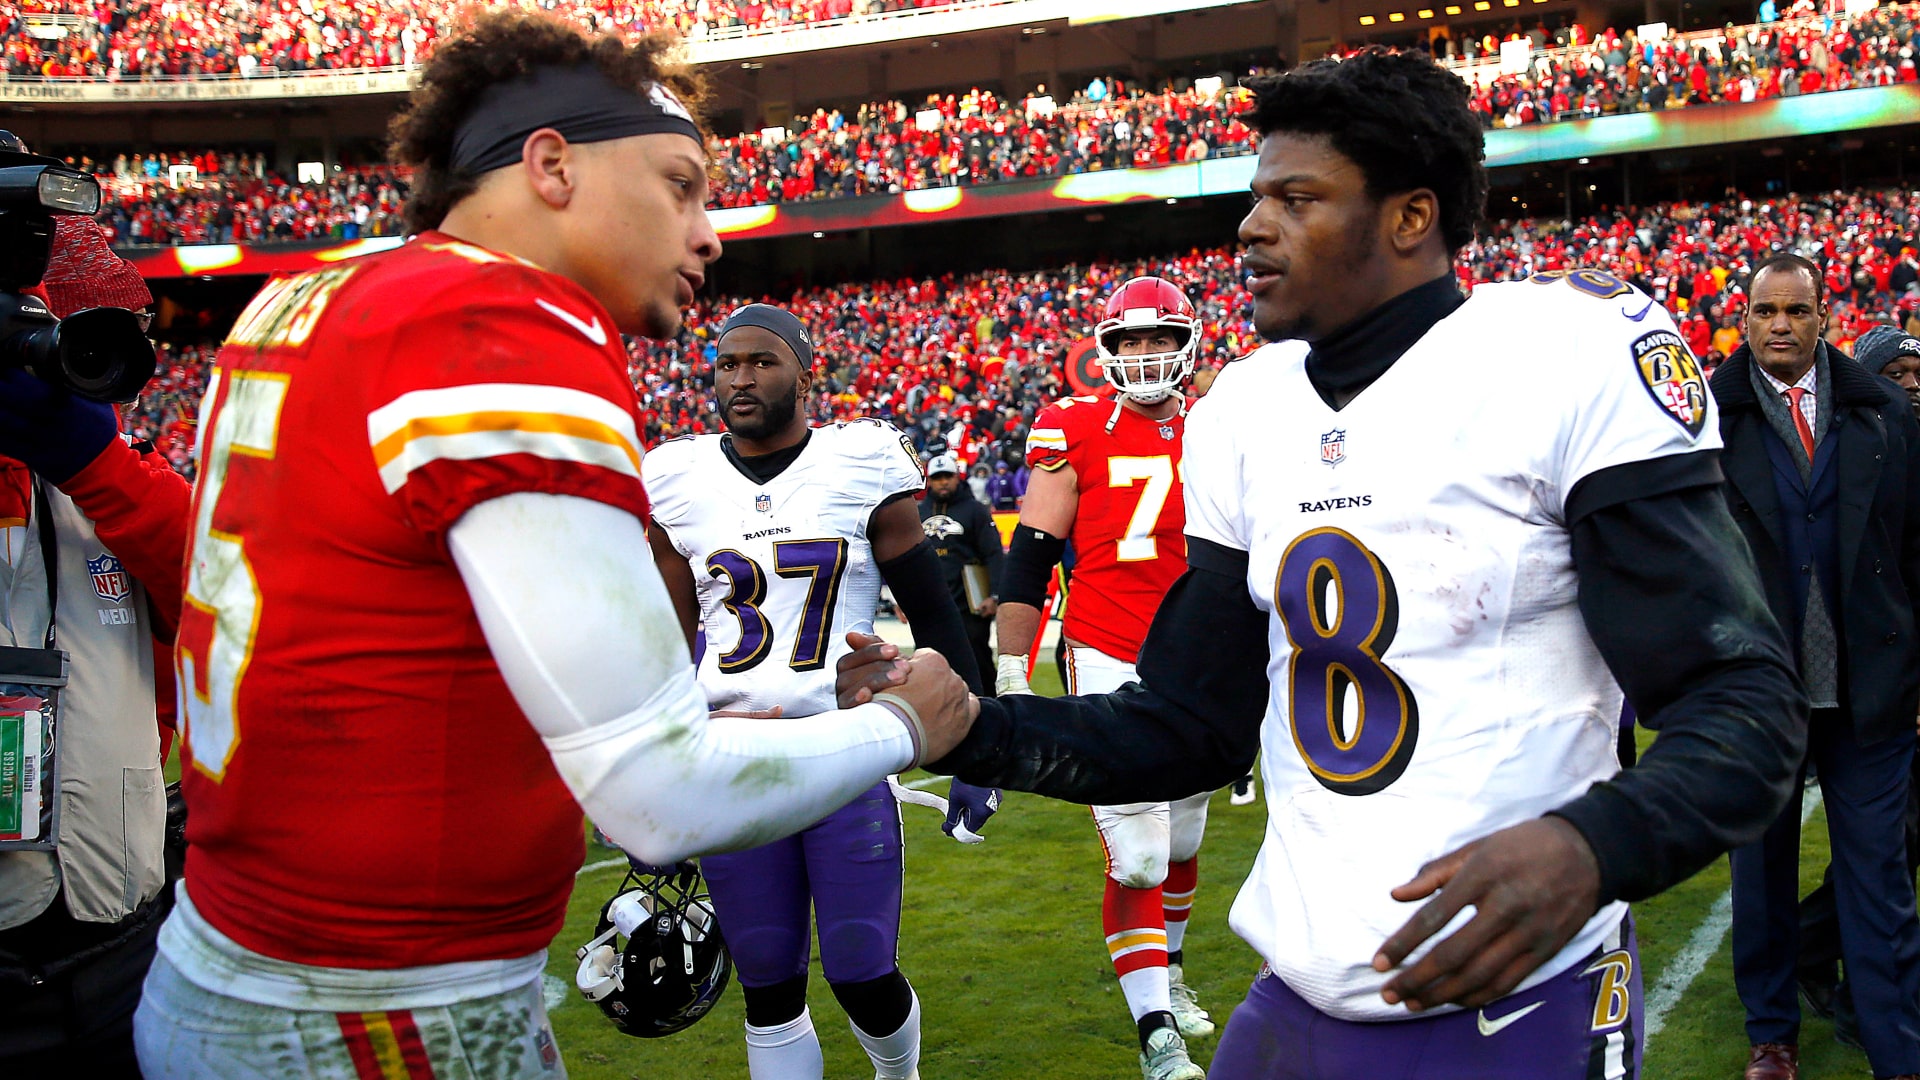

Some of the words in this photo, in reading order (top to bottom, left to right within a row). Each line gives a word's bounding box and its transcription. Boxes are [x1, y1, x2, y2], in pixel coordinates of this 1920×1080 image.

[21, 305, 47, 314] Canon
[1635, 333, 1681, 355] RAVENS
[1323, 443, 1342, 460] NFL
[1107, 454, 1186, 562] 7
[1298, 495, 1372, 513] RAVENS
[742, 526, 792, 541] RAVENS
[93, 573, 129, 596] NFL
[705, 538, 848, 674] 37
[1274, 526, 1419, 797] 8
[3, 751, 15, 782] ACCESS
[2, 784, 14, 798] ALL
[1578, 951, 1632, 1031] B
